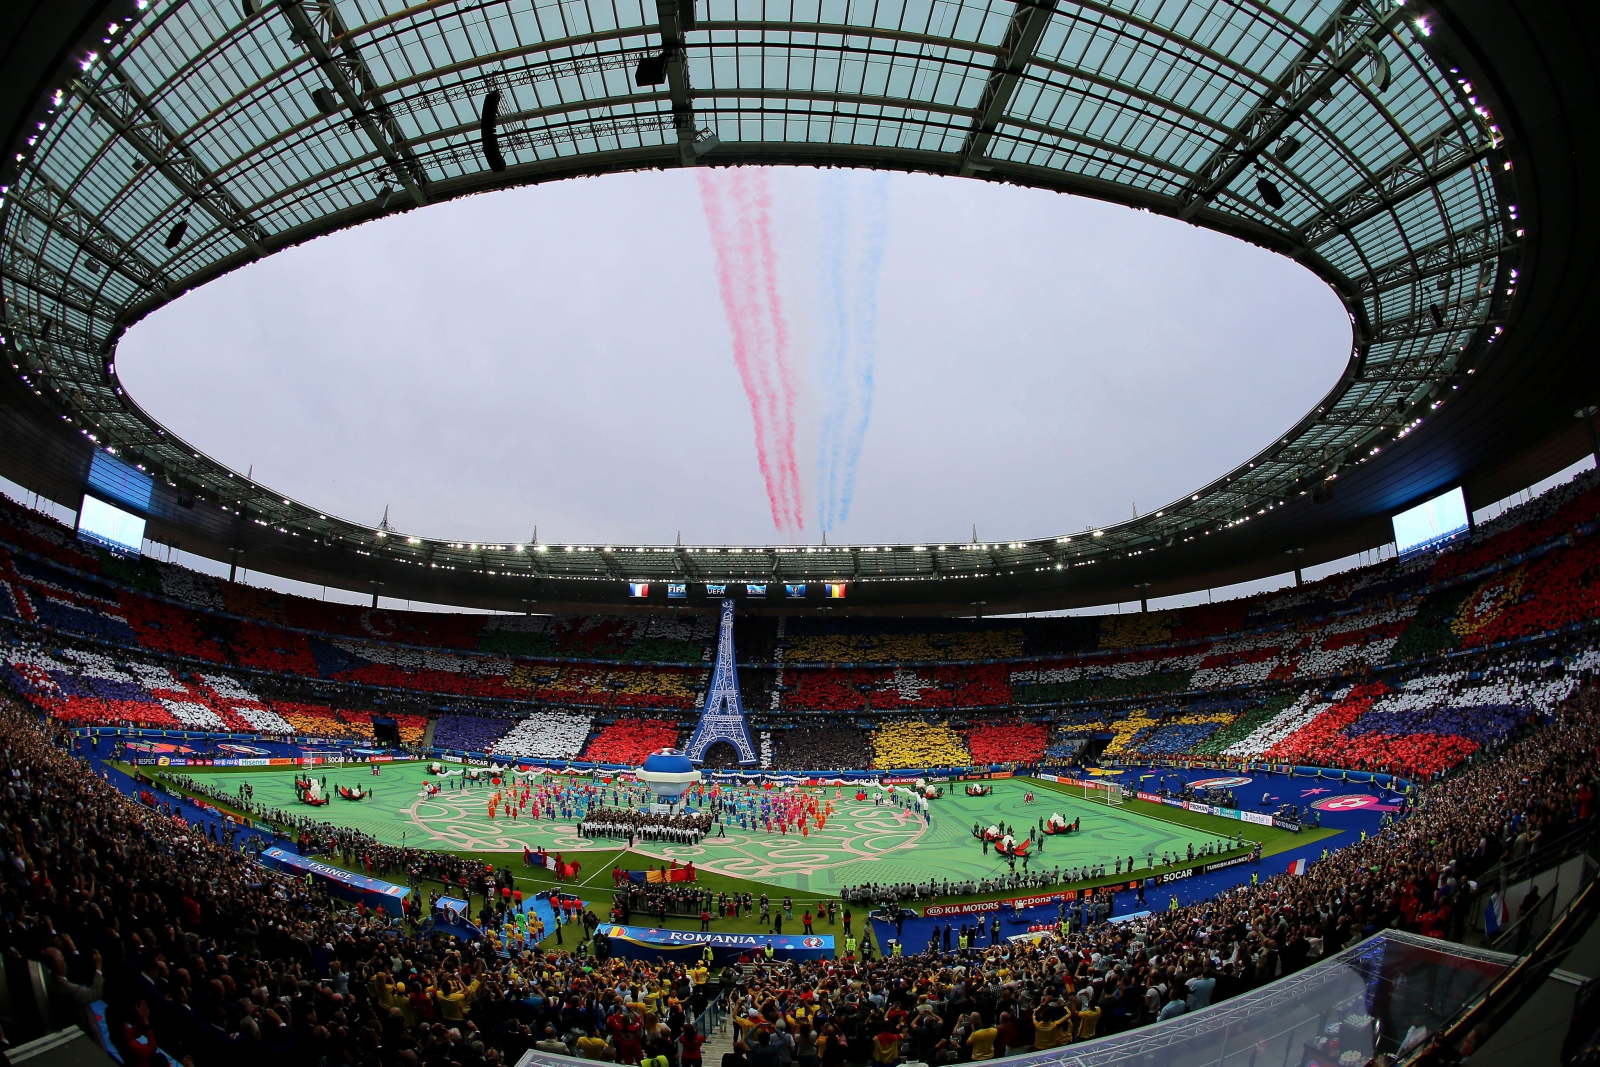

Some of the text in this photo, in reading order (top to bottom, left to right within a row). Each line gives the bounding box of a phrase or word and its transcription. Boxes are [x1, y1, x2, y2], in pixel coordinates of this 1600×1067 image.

[467, 758, 489, 766] SOCAR
[1190, 802, 1208, 812] PROMAN
[307, 862, 355, 880] FRANCE
[1162, 868, 1193, 883] SOCAR
[1098, 884, 1124, 894] Orange
[944, 905, 961, 914] KIA
[962, 901, 999, 912] MOTORS
[670, 931, 757, 945] ROMANIA
